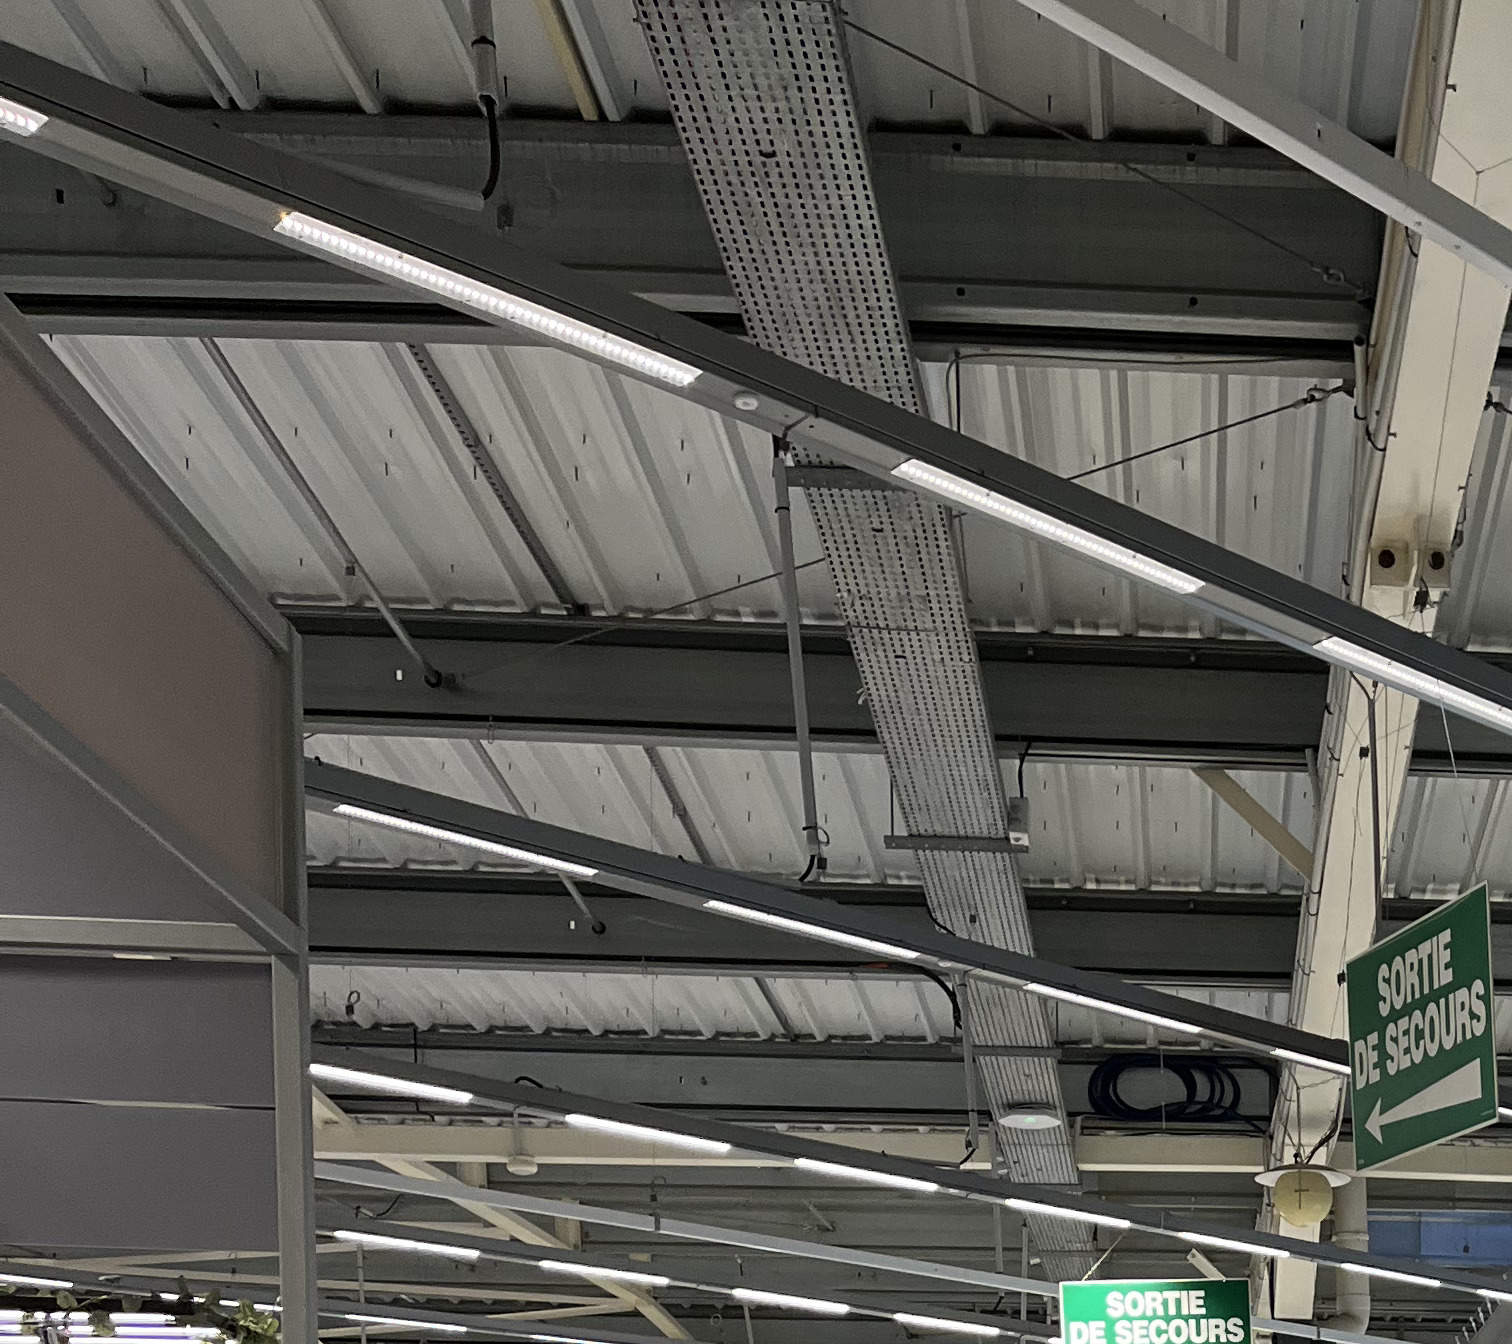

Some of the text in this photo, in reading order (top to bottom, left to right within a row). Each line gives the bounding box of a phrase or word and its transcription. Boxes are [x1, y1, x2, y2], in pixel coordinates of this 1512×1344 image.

[1377, 928, 1453, 1017] SORTIE
[1354, 979, 1487, 1091] DE SECOURS
[1106, 1290, 1207, 1318] SORTIE
